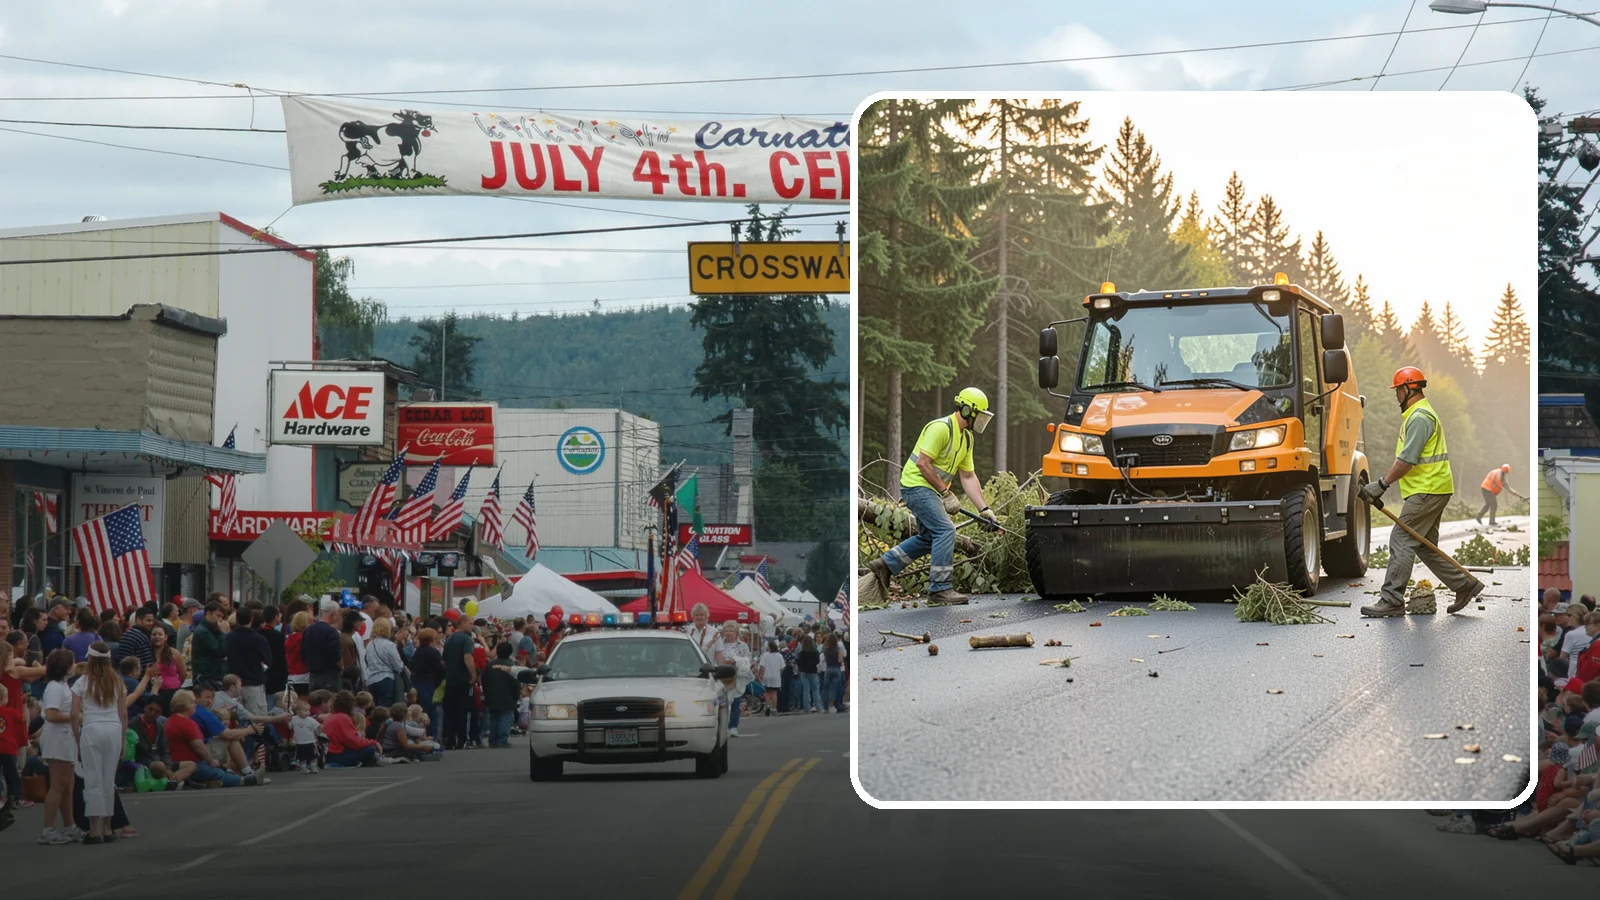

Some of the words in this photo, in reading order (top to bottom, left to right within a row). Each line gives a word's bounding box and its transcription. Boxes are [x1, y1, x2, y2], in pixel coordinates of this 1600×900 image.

[481, 141, 605, 193] JULY
[632, 150, 747, 198] 4th.
[696, 254, 851, 281] CROSSWA
[282, 380, 374, 420] ACE
[405, 409, 453, 422] CEDAR
[283, 420, 371, 437] Hardware
[416, 428, 477, 447] Coca-Cola
[95, 484, 125, 495] Vincent
[126, 486, 136, 494] de
[137, 486, 155, 496] Paul
[688, 526, 741, 535] CRNATION
[699, 535, 730, 543] GLASS
